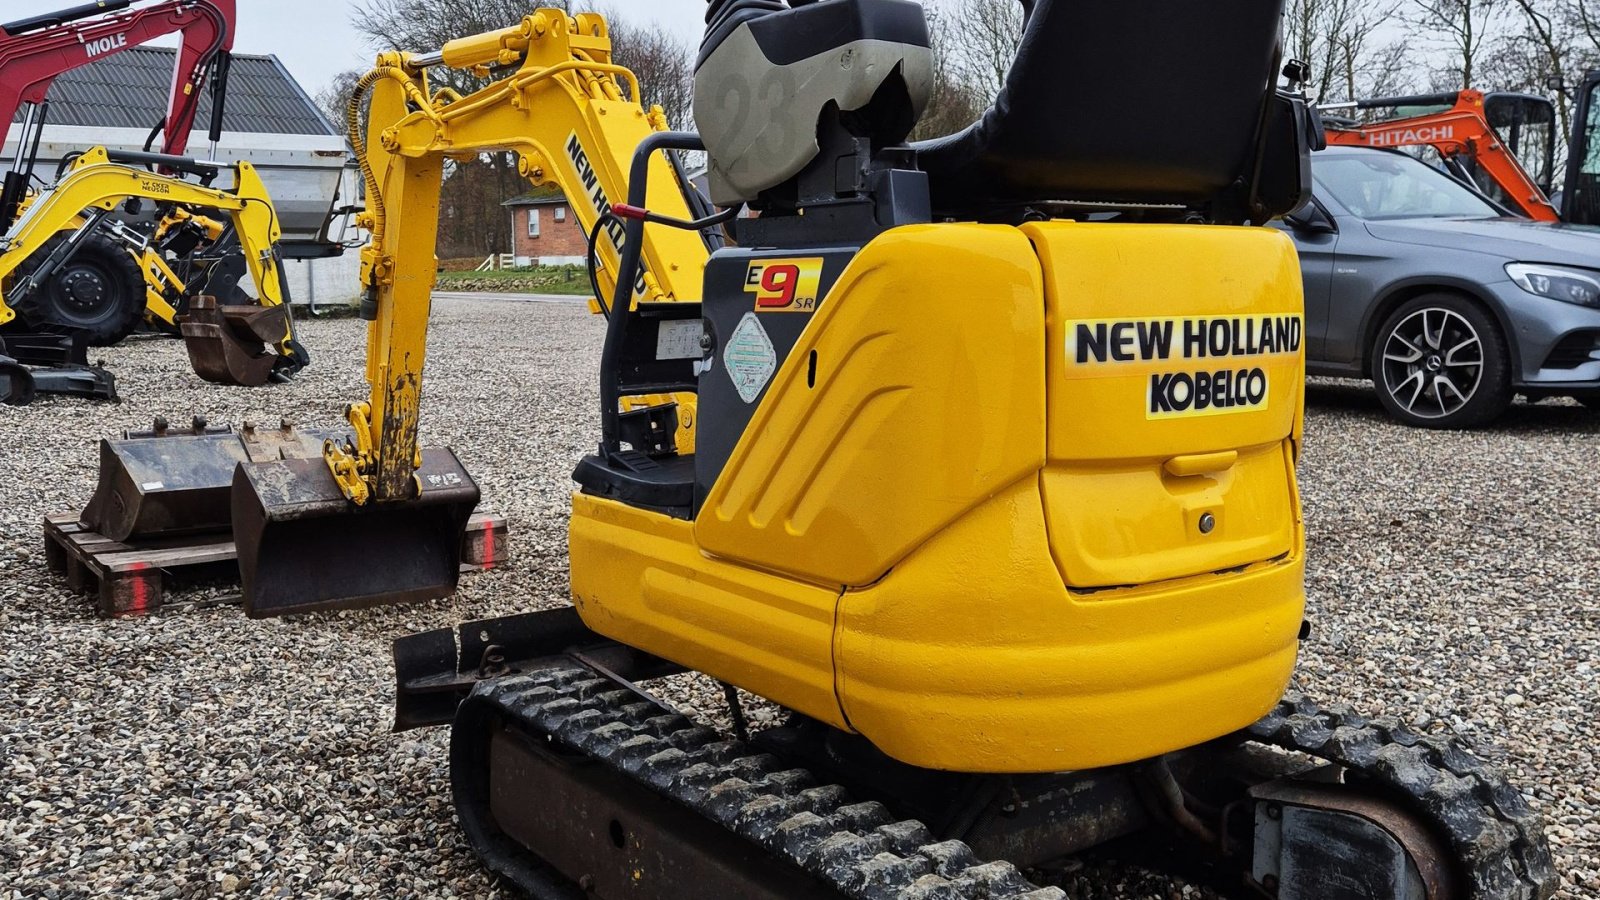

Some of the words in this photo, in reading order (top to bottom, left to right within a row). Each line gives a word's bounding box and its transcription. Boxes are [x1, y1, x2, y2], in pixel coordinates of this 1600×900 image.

[86, 32, 127, 58] MOLE
[1369, 125, 1453, 146] HITACHI
[567, 134, 598, 191] NEW
[1076, 320, 1173, 364] NEW
[1183, 316, 1301, 358] HOLLAND
[1150, 367, 1266, 413] KOBELCO
